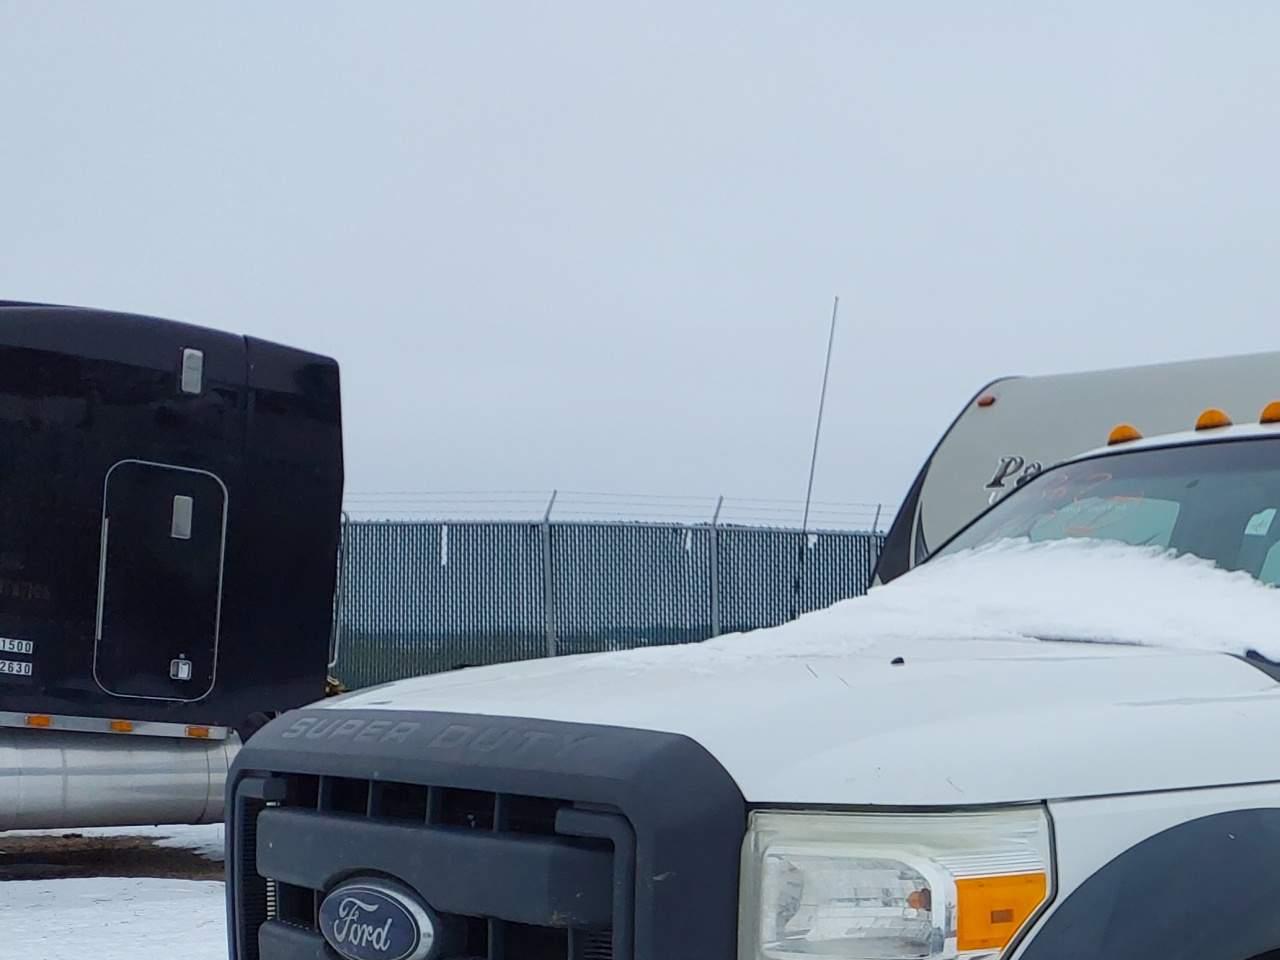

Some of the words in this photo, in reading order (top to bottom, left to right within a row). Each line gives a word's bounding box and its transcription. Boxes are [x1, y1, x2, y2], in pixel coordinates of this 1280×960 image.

[282, 717, 423, 745] SUPER
[429, 725, 597, 757] DUTY
[333, 897, 392, 951] Ford
